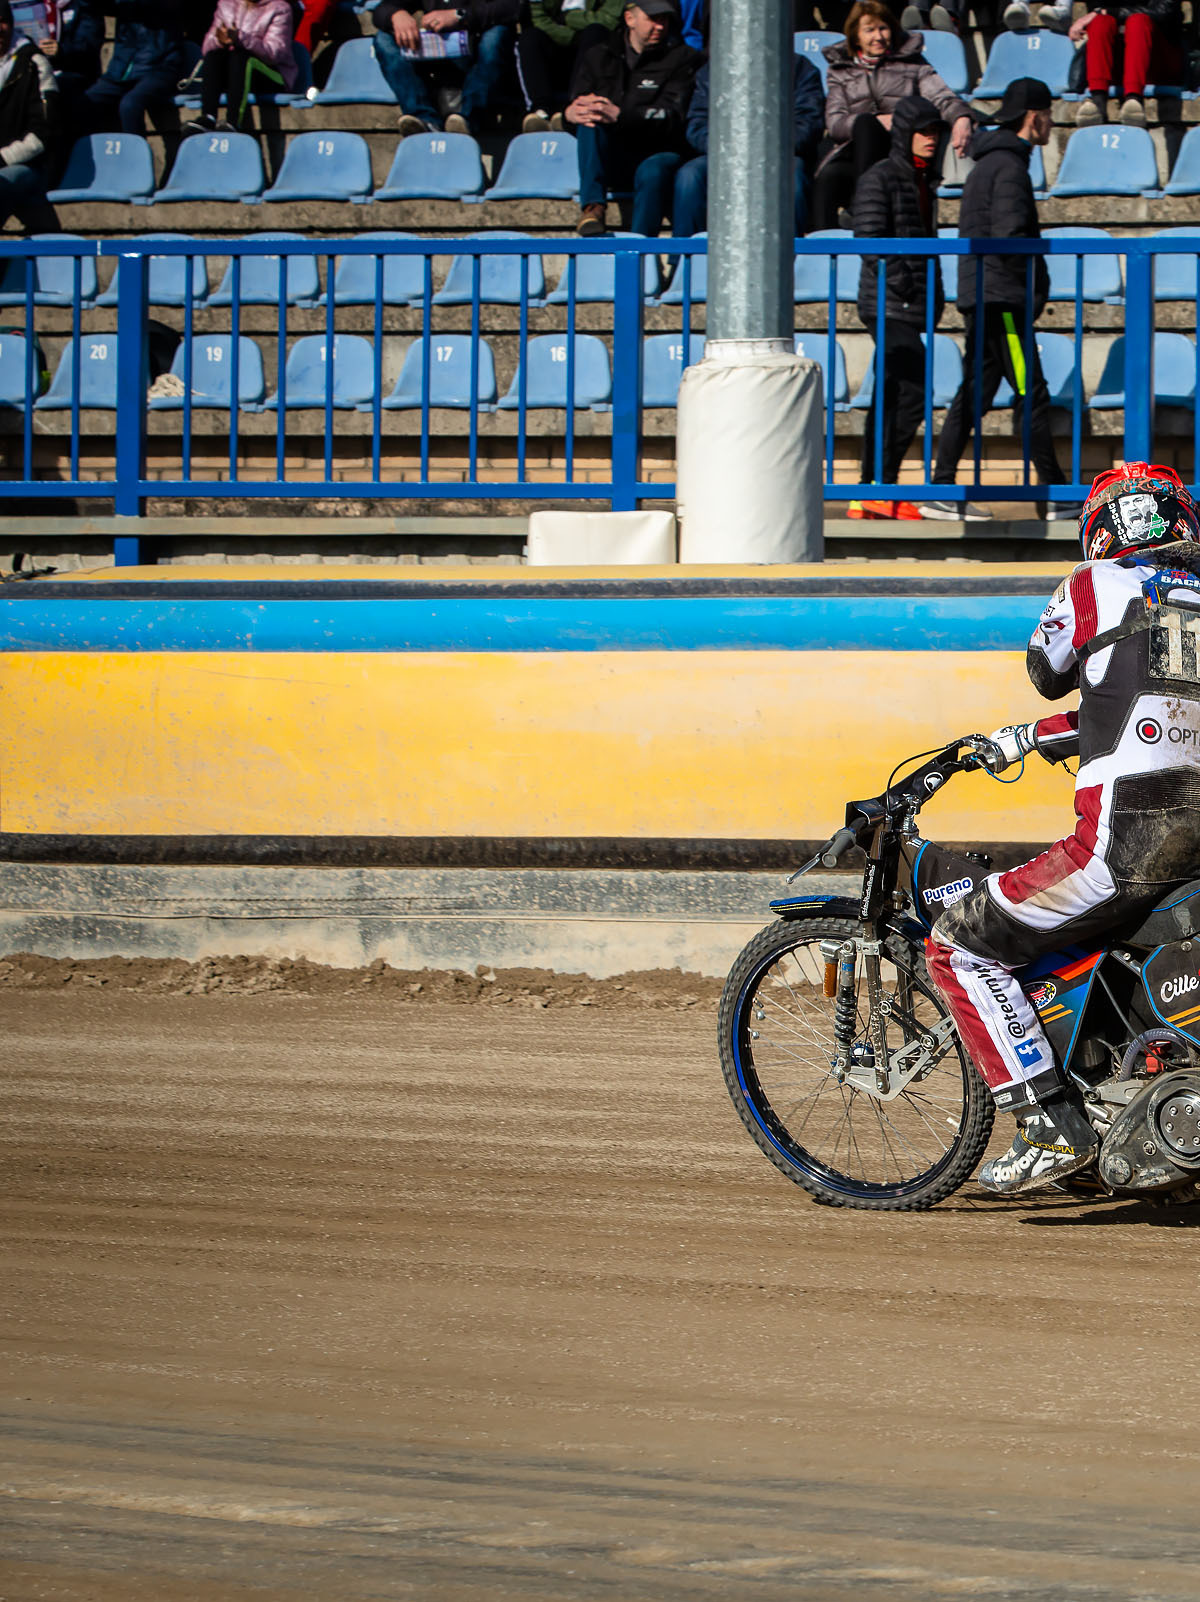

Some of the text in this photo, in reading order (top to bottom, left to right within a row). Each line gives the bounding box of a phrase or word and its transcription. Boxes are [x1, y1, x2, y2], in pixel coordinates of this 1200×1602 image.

[803, 38, 820, 52] 15
[1026, 36, 1041, 50] 13
[104, 140, 121, 155] 21
[317, 140, 334, 155] 19
[541, 140, 558, 155] 17
[1101, 133, 1121, 149] 12
[89, 344, 107, 360] 20
[205, 346, 223, 362] 19
[436, 346, 453, 362] 17
[550, 346, 567, 362] 16
[924, 878, 972, 903] Pureno
[1160, 974, 1200, 1003] Cille
